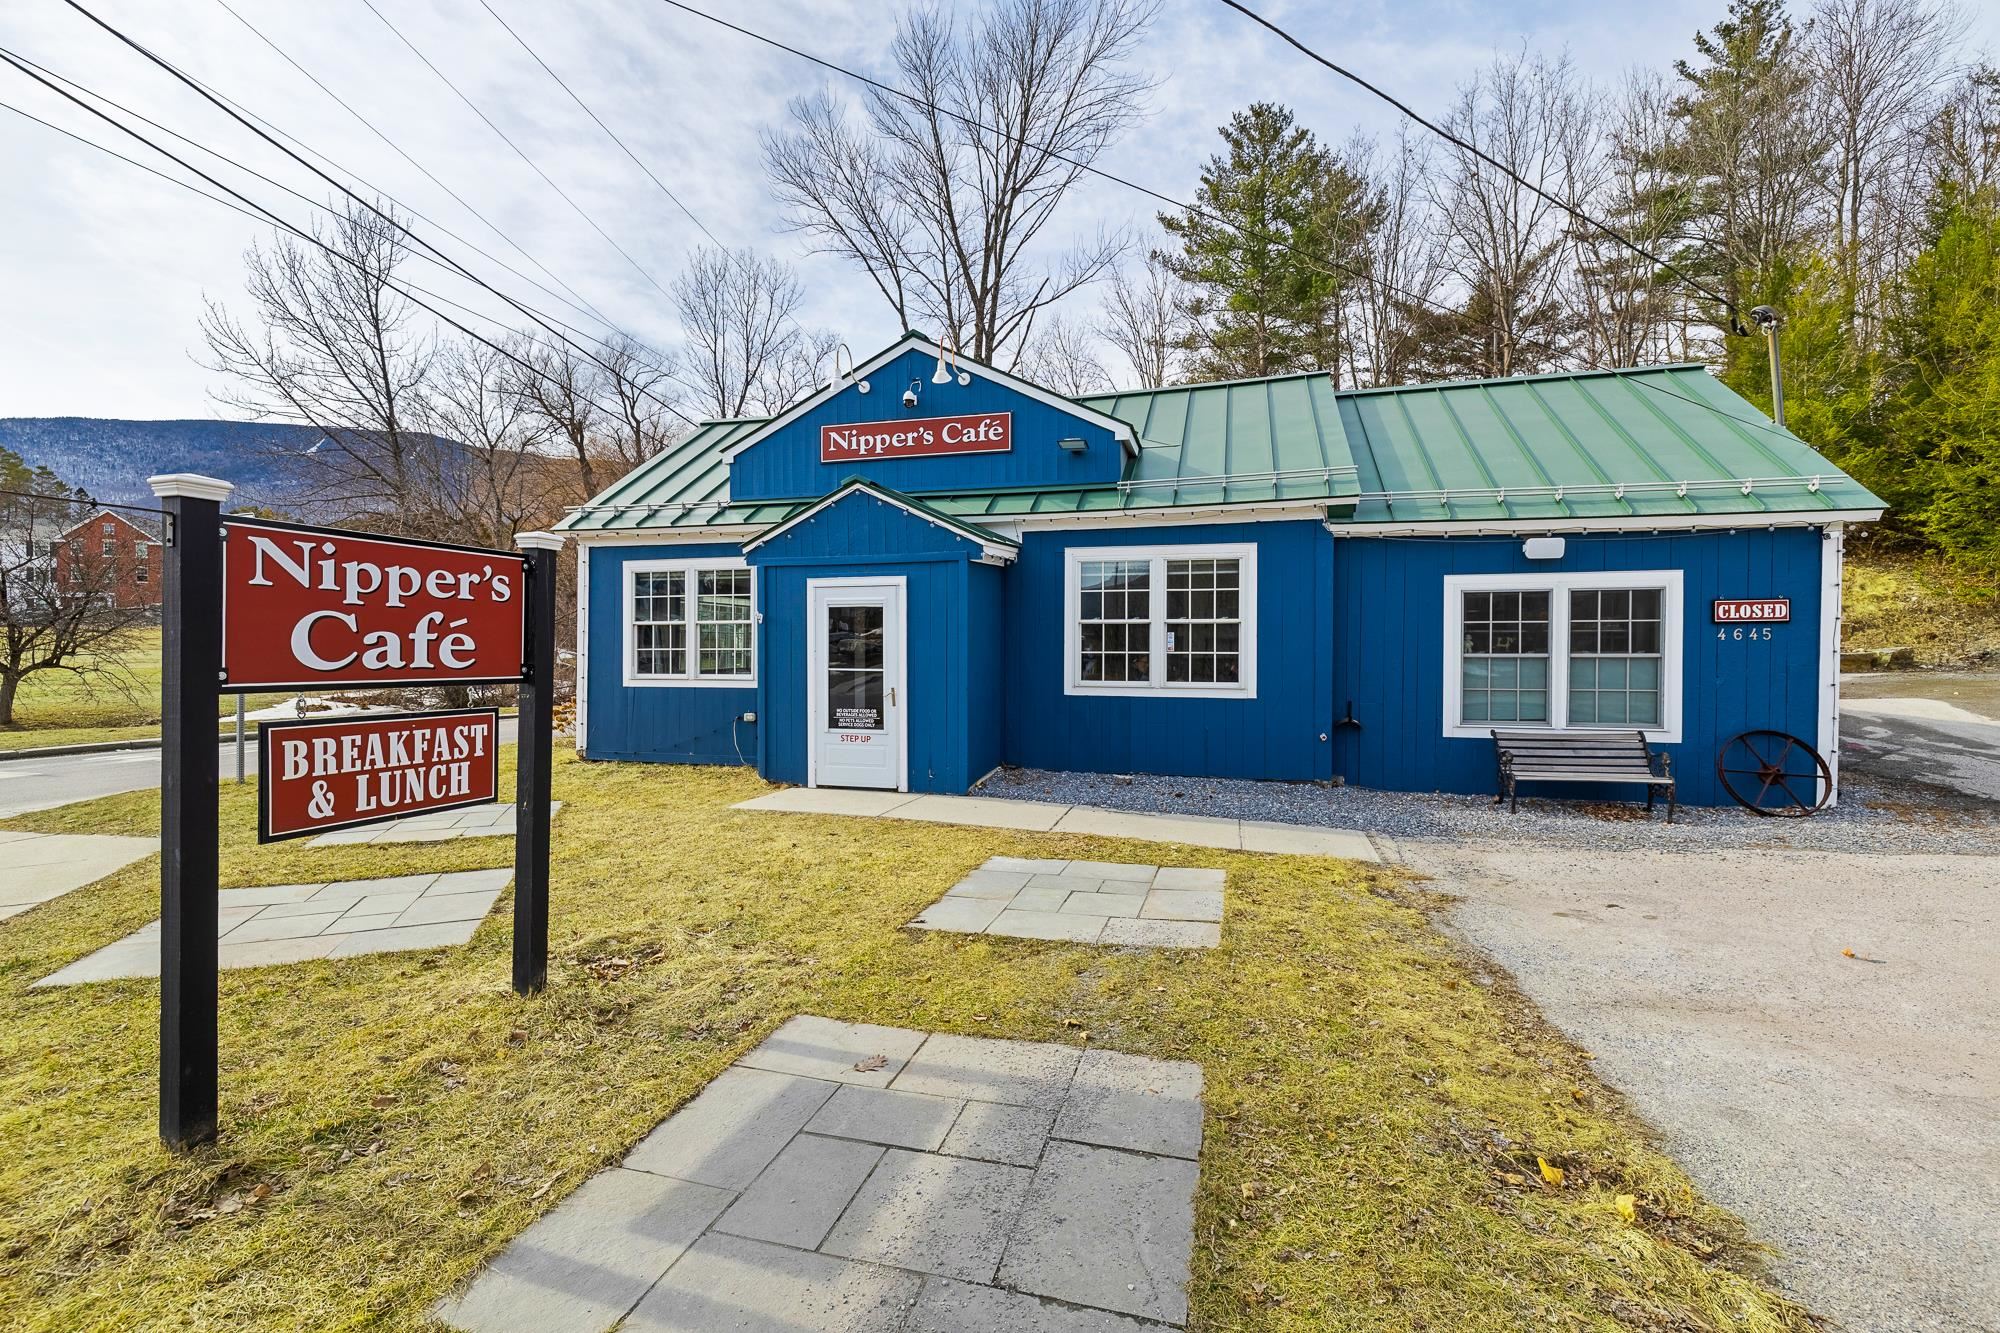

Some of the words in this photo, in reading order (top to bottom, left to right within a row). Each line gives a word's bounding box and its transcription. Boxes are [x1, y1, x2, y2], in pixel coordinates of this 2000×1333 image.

[829, 427, 934, 454] Nipper's
[941, 419, 1004, 444] Café
[247, 536, 512, 607] Nipper's
[1718, 603, 1787, 618] CLOSED
[290, 610, 476, 671] Café
[282, 724, 488, 781] BREAKFAST
[307, 780, 335, 819] &
[356, 761, 471, 812] LUNCH
